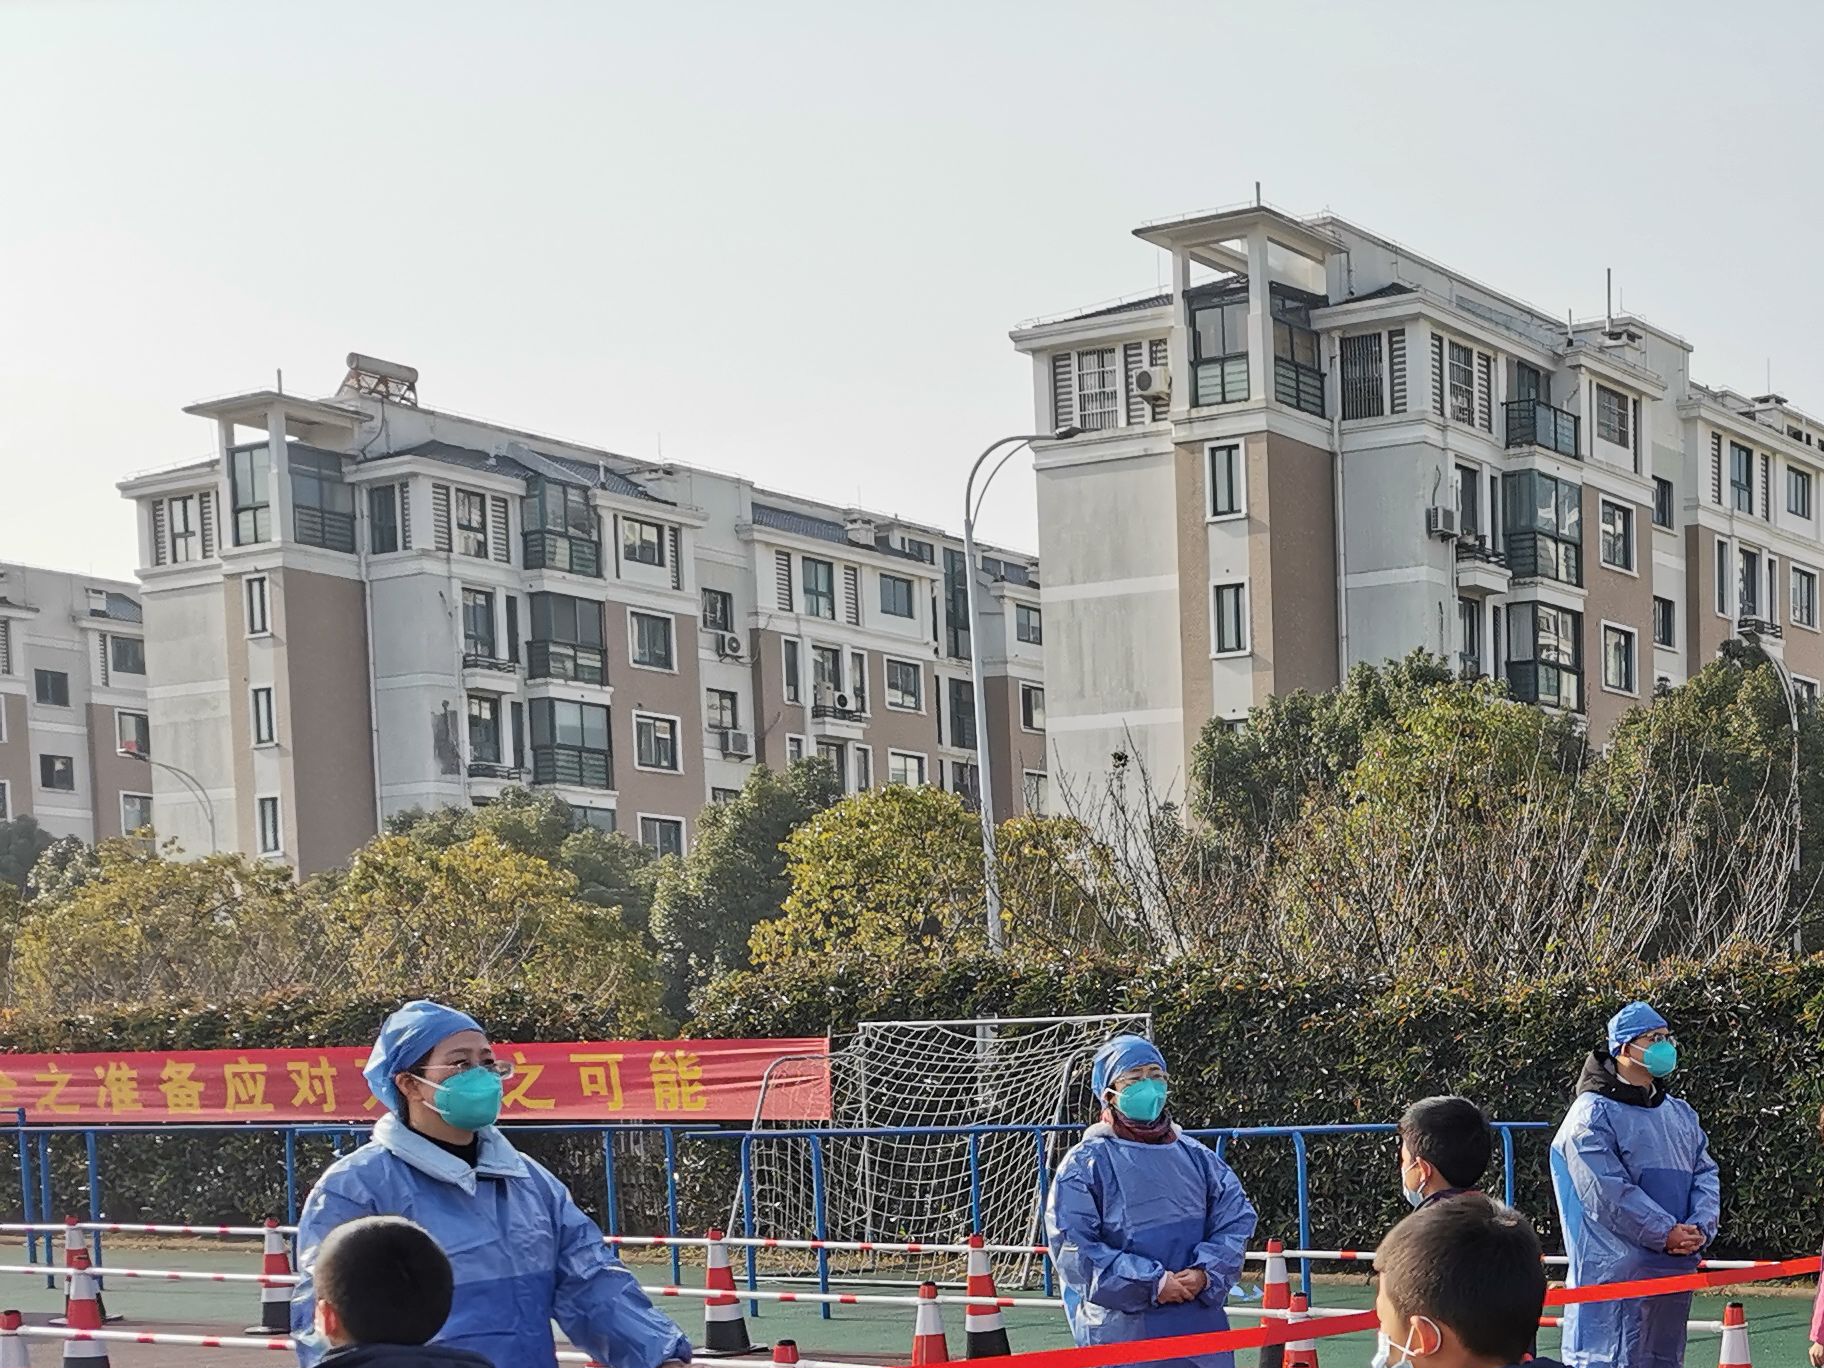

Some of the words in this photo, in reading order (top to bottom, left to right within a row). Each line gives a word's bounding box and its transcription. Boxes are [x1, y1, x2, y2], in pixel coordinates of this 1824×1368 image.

[0, 1050, 707, 1115] 之准备应对之可能
